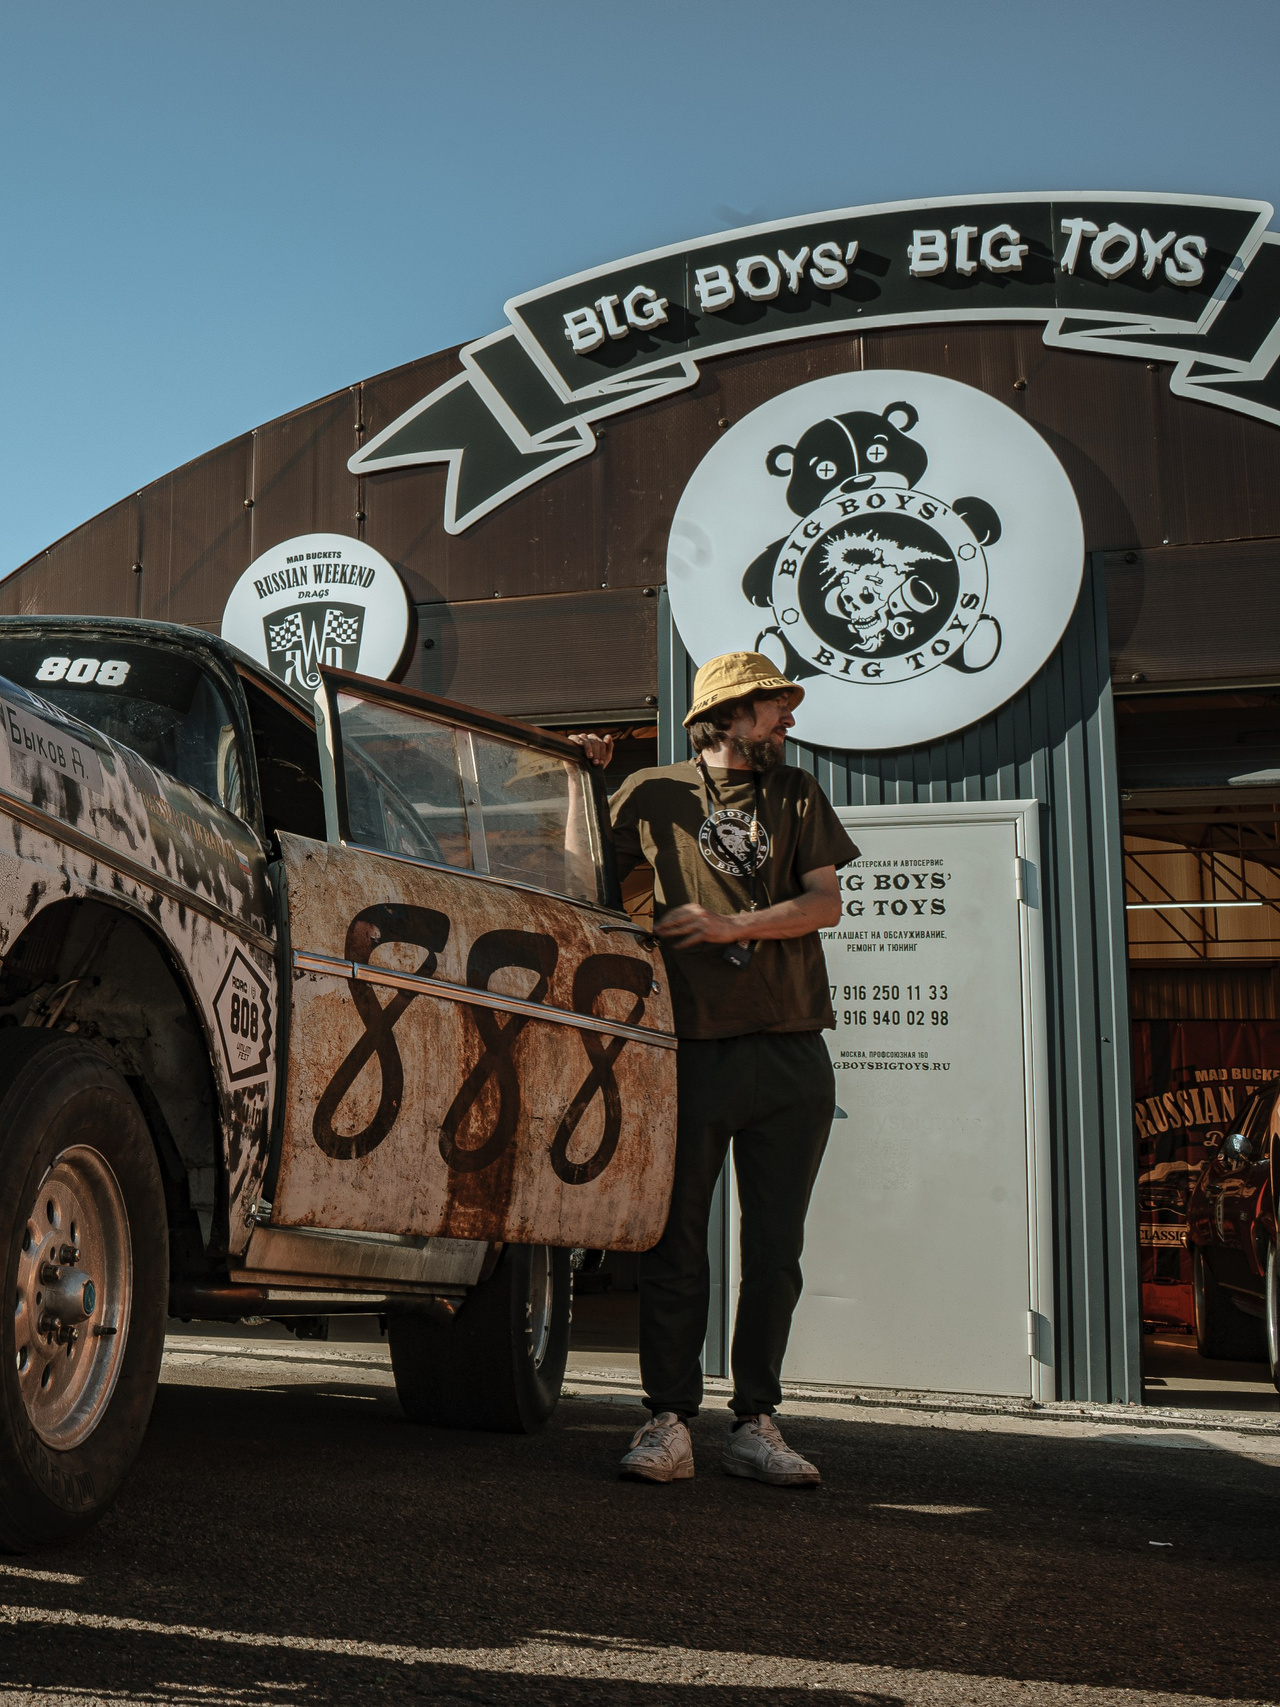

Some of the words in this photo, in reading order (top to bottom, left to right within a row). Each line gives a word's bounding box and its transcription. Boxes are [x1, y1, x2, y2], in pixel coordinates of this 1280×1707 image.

[562, 285, 669, 355] BIG
[694, 241, 859, 313] BOYS'
[907, 223, 1029, 278] BIG
[1060, 217, 1207, 287] TOYS
[778, 519, 824, 579] BIG
[836, 492, 949, 521] BOYS'
[286, 554, 304, 565] MAD
[306, 551, 342, 561] BUCKETS
[253, 565, 309, 600] RUSSIAN
[312, 563, 376, 589] WEEKEND
[297, 588, 330, 599] DRAGS
[811, 644, 885, 679] BIG
[905, 592, 981, 672] TOYS
[35, 656, 131, 687] 808
[6, 705, 67, 769] Быков
[717, 860, 741, 874] BIG
[743, 845, 768, 875] TYS
[900, 859, 944, 867] АВТОСЕРВИС
[837, 874, 866, 891] IG
[873, 872, 952, 891] BOYS'
[873, 898, 947, 916] TOYS
[820, 931, 868, 940] ПРИГЛАШАЕТ
[870, 931, 881, 939] НА
[884, 930, 948, 940] ОБСЛУЖИВАНИЕ,
[847, 943, 877, 952] РЕМОНТ
[879, 944, 885, 952] И
[887, 943, 918, 952] ТЮНИНГ
[231, 974, 248, 994] RDRC
[843, 985, 867, 1001] 916
[872, 985, 900, 1001] 250
[907, 985, 920, 1001] 11
[928, 985, 948, 1001] 33
[230, 992, 259, 1044] 808
[843, 1010, 867, 1026] 916
[872, 1010, 900, 1026] 940
[907, 1010, 925, 1026] 02
[931, 1010, 949, 1026] 98
[236, 1042, 252, 1053] UNLIM
[312, 902, 654, 1186] 888
[237, 1051, 251, 1062] FEST
[840, 1050, 867, 1059] МОСКВА,
[869, 1050, 916, 1059] ПРОФСОЮЗНАЯ
[918, 1051, 929, 1059] 160
[833, 1061, 951, 1071] GBOYSBIGTOYS.RU
[1194, 1068, 1228, 1083] MAD
[1135, 1085, 1236, 1139] RUSSIAN
